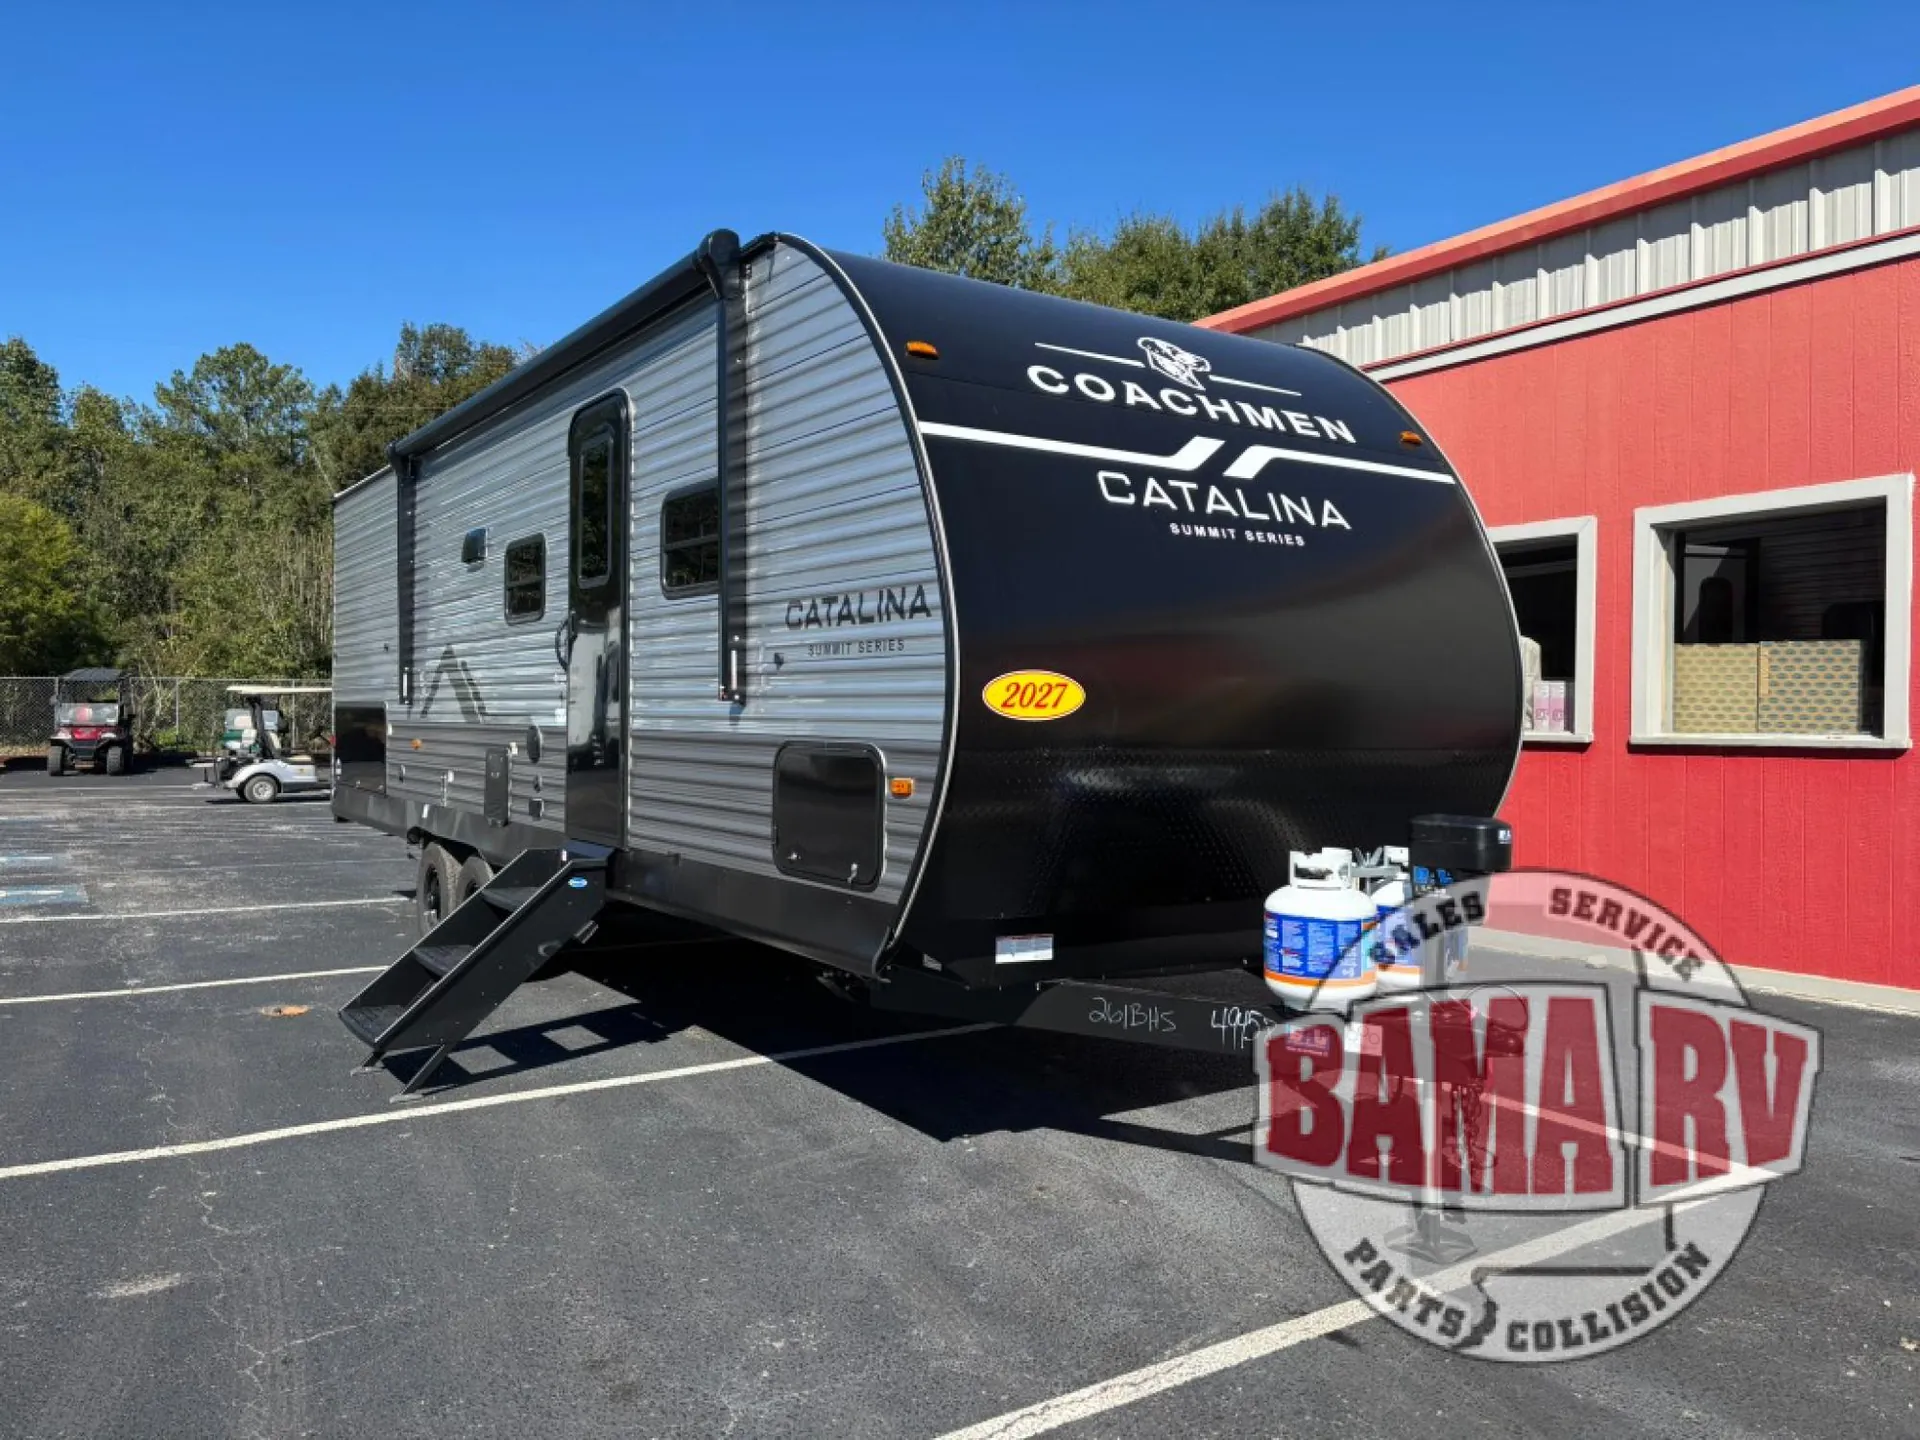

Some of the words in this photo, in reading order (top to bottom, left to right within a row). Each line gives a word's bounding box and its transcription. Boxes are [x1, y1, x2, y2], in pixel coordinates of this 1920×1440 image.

[1027, 365, 1356, 443] COACHMEN
[1097, 471, 1351, 530] CATALINA
[1169, 522, 1236, 541] SUMMIT
[1244, 531, 1305, 547] SERIES
[785, 584, 931, 629] CATALINA
[807, 643, 851, 657] SUMMIT
[858, 639, 904, 653] SERIES
[1001, 682, 1068, 709] 2027
